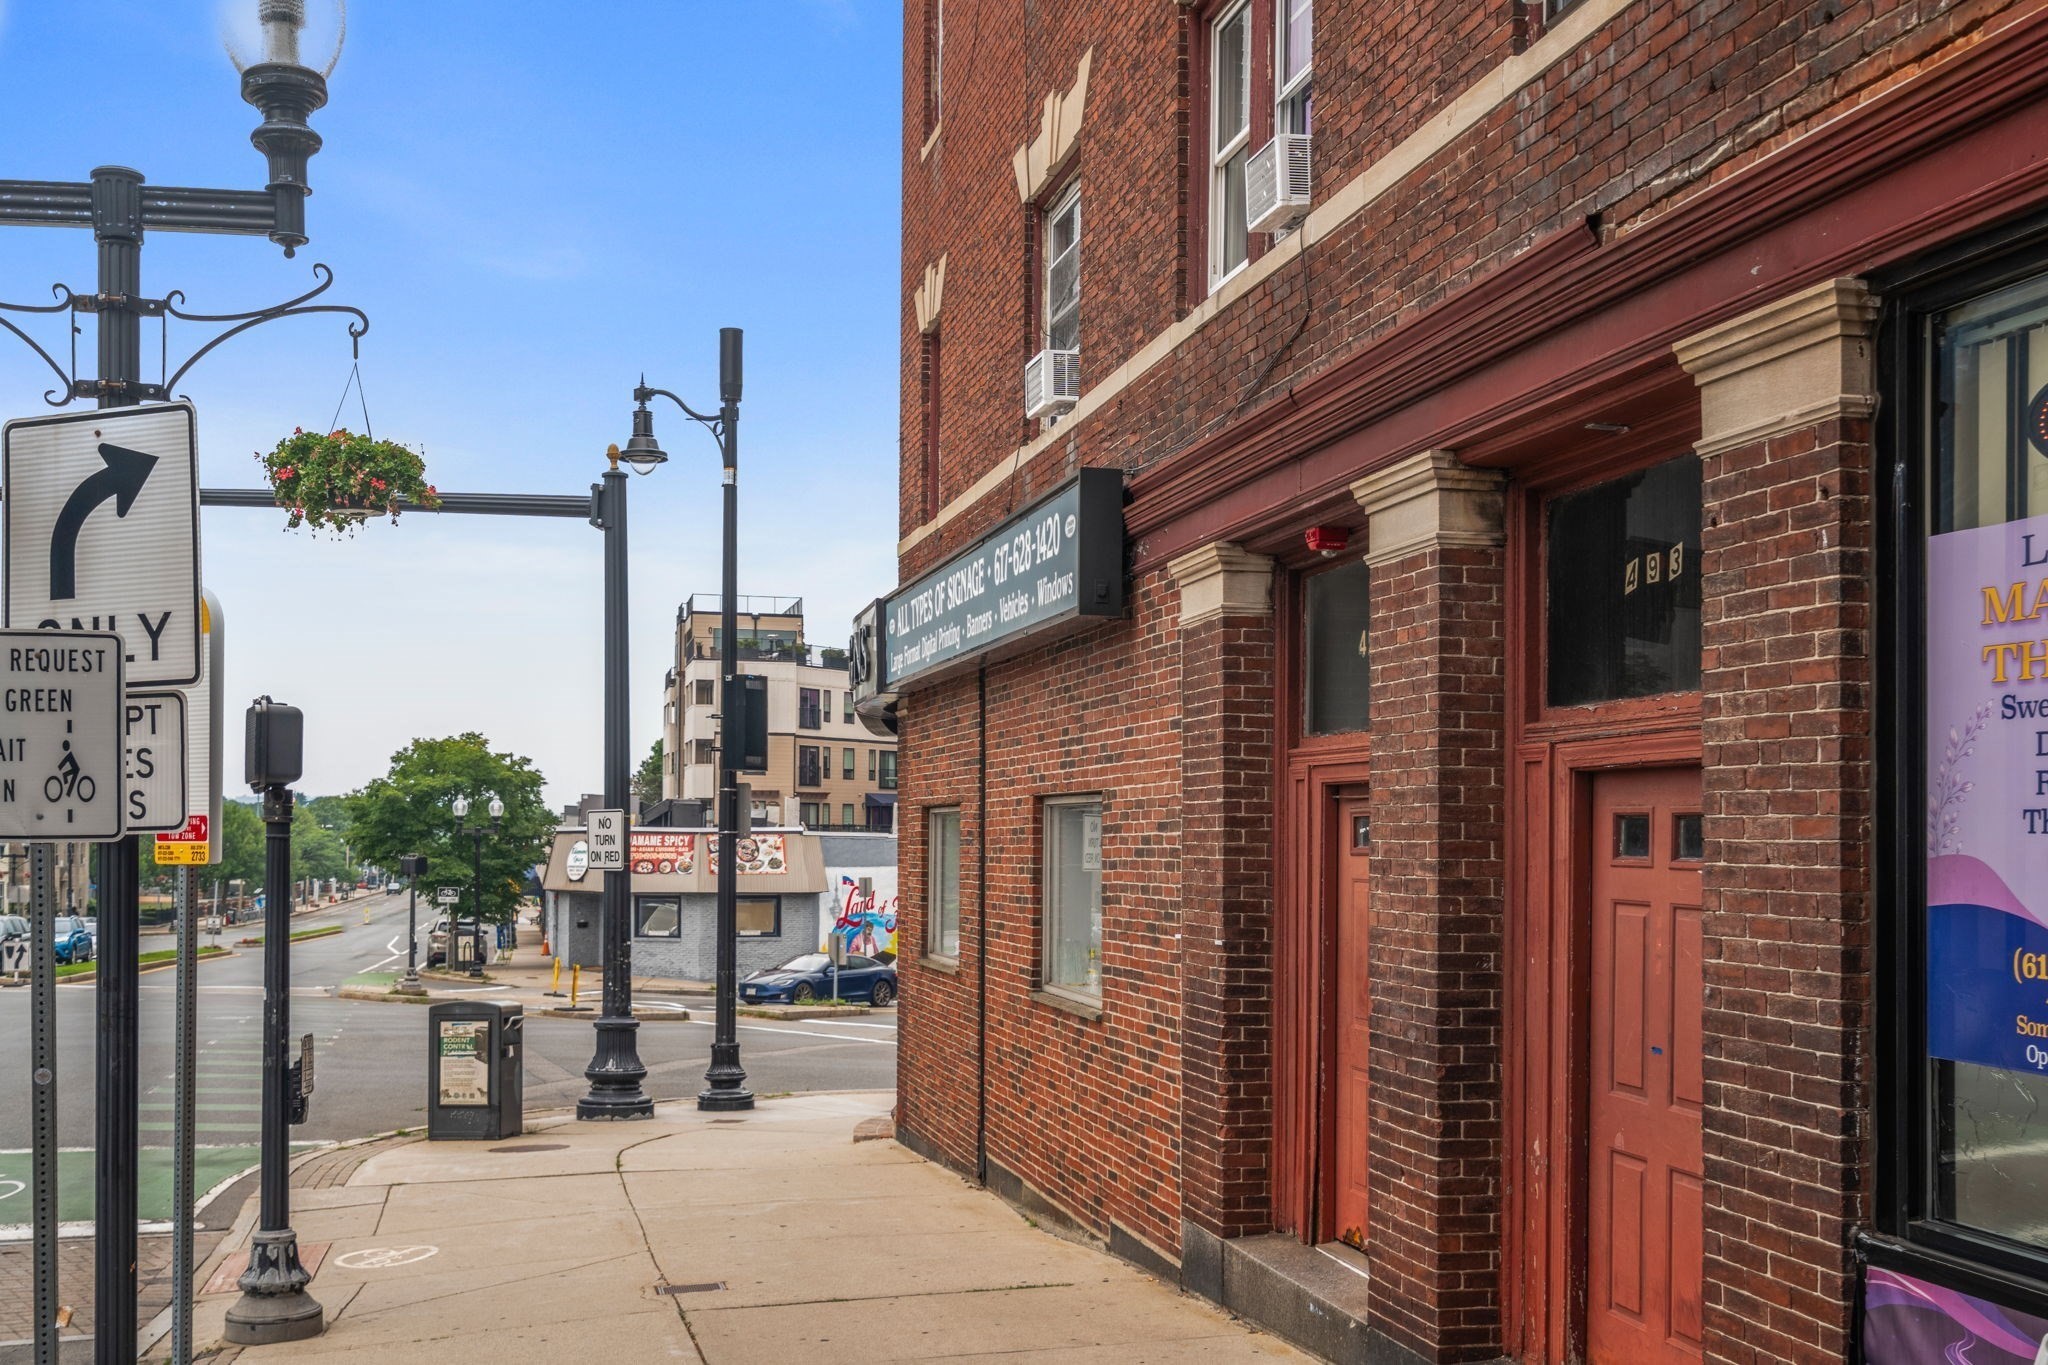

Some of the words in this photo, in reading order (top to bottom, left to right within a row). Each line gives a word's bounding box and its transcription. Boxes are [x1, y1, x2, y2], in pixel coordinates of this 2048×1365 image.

[897, 603, 910, 637] ALL
[911, 588, 933, 630] TYPES
[934, 580, 946, 617] OF
[947, 557, 985, 610] SIGNAGE
[993, 512, 1061, 586] 617-628-1420
[1626, 546, 1682, 590] 493
[891, 652, 903, 675] Large
[921, 630, 938, 662] Digital
[938, 621, 961, 649] Printing
[966, 610, 993, 638] Banners
[1000, 589, 1029, 623] Vehicles
[1037, 571, 1073, 606] Windows
[10, 648, 105, 673] REQUEST
[6, 689, 72, 712] GREEN
[598, 818, 612, 829] NO
[181, 832, 196, 840] ZONE
[595, 835, 616, 846] TURN
[631, 835, 663, 846] AMAME
[663, 835, 690, 846] SPICY
[590, 851, 602, 862] ON
[605, 851, 620, 863] RED
